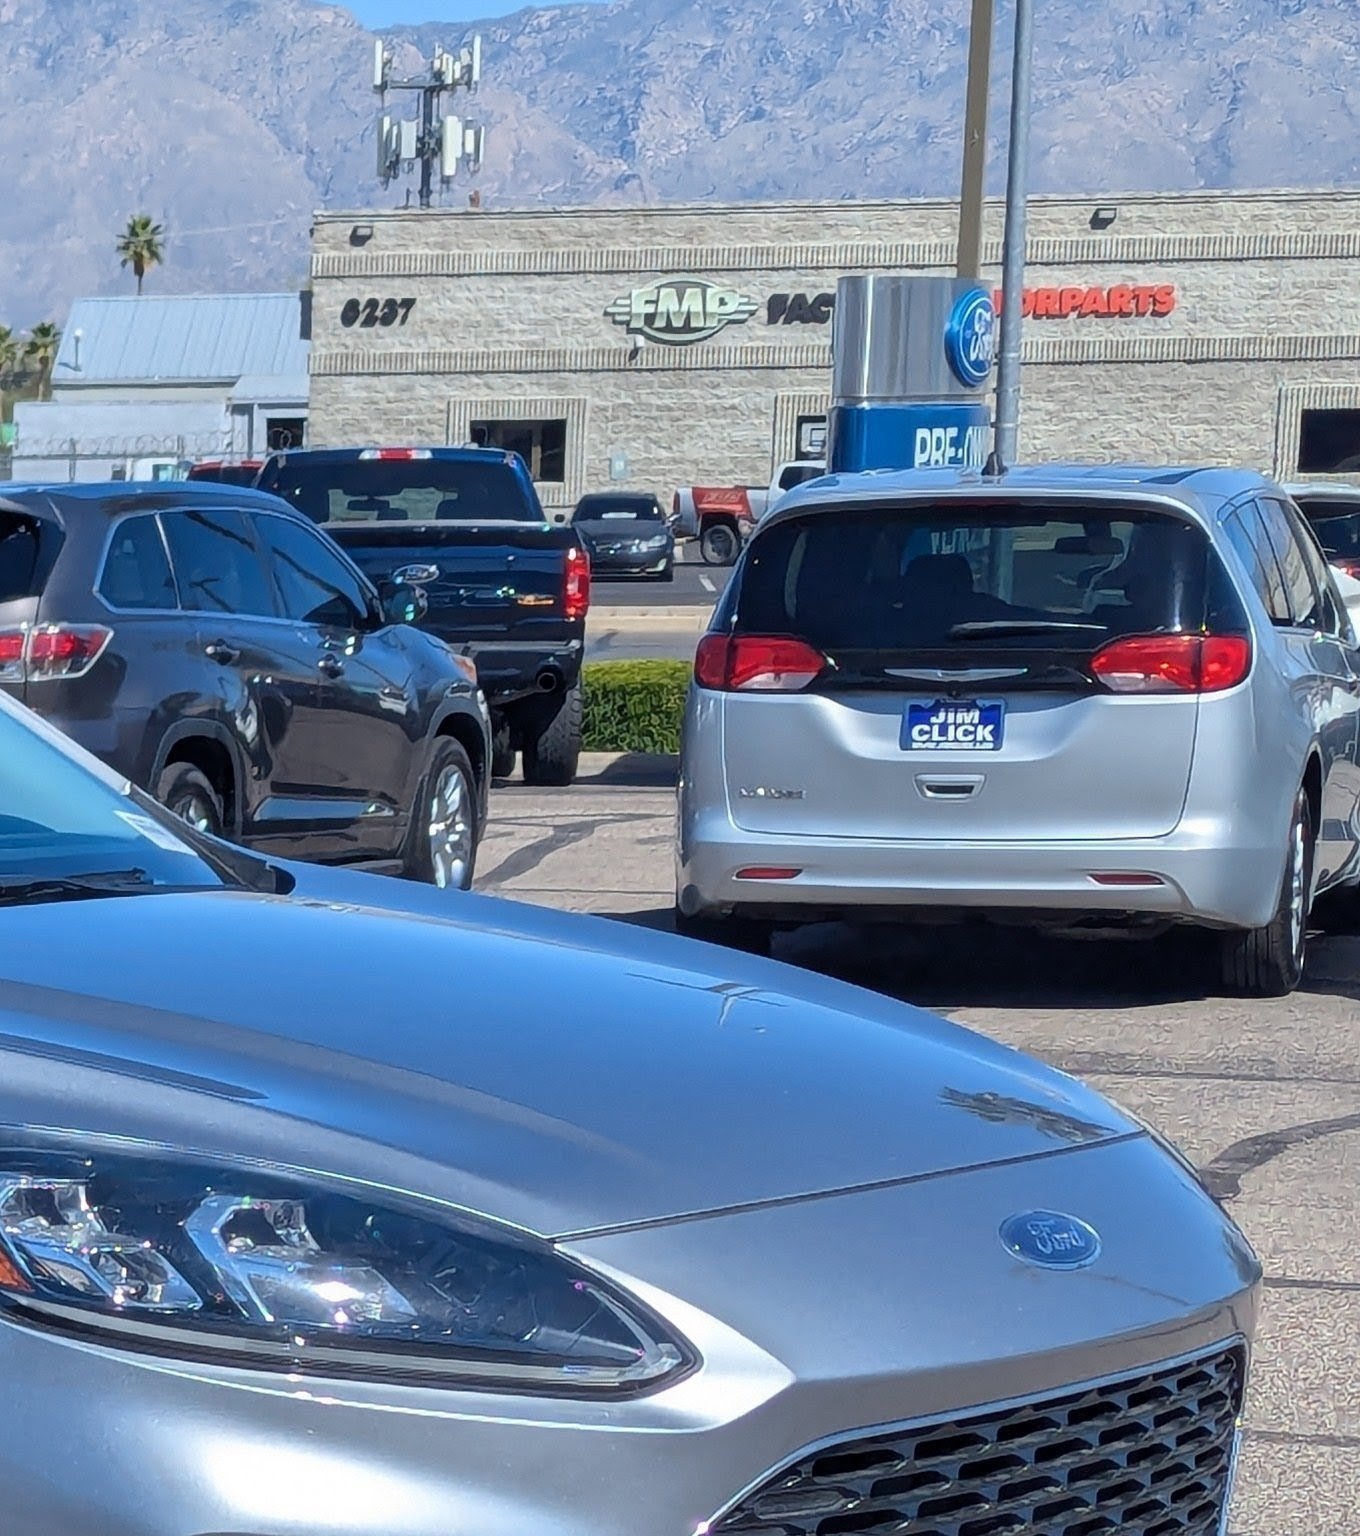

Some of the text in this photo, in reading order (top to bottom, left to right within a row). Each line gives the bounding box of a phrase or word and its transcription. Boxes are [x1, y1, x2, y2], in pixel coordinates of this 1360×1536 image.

[340, 297, 417, 328] 6237
[629, 287, 739, 329] FMP
[930, 708, 980, 724] JIM
[911, 724, 995, 742] CLICK
[1028, 1220, 1086, 1254] Ford
